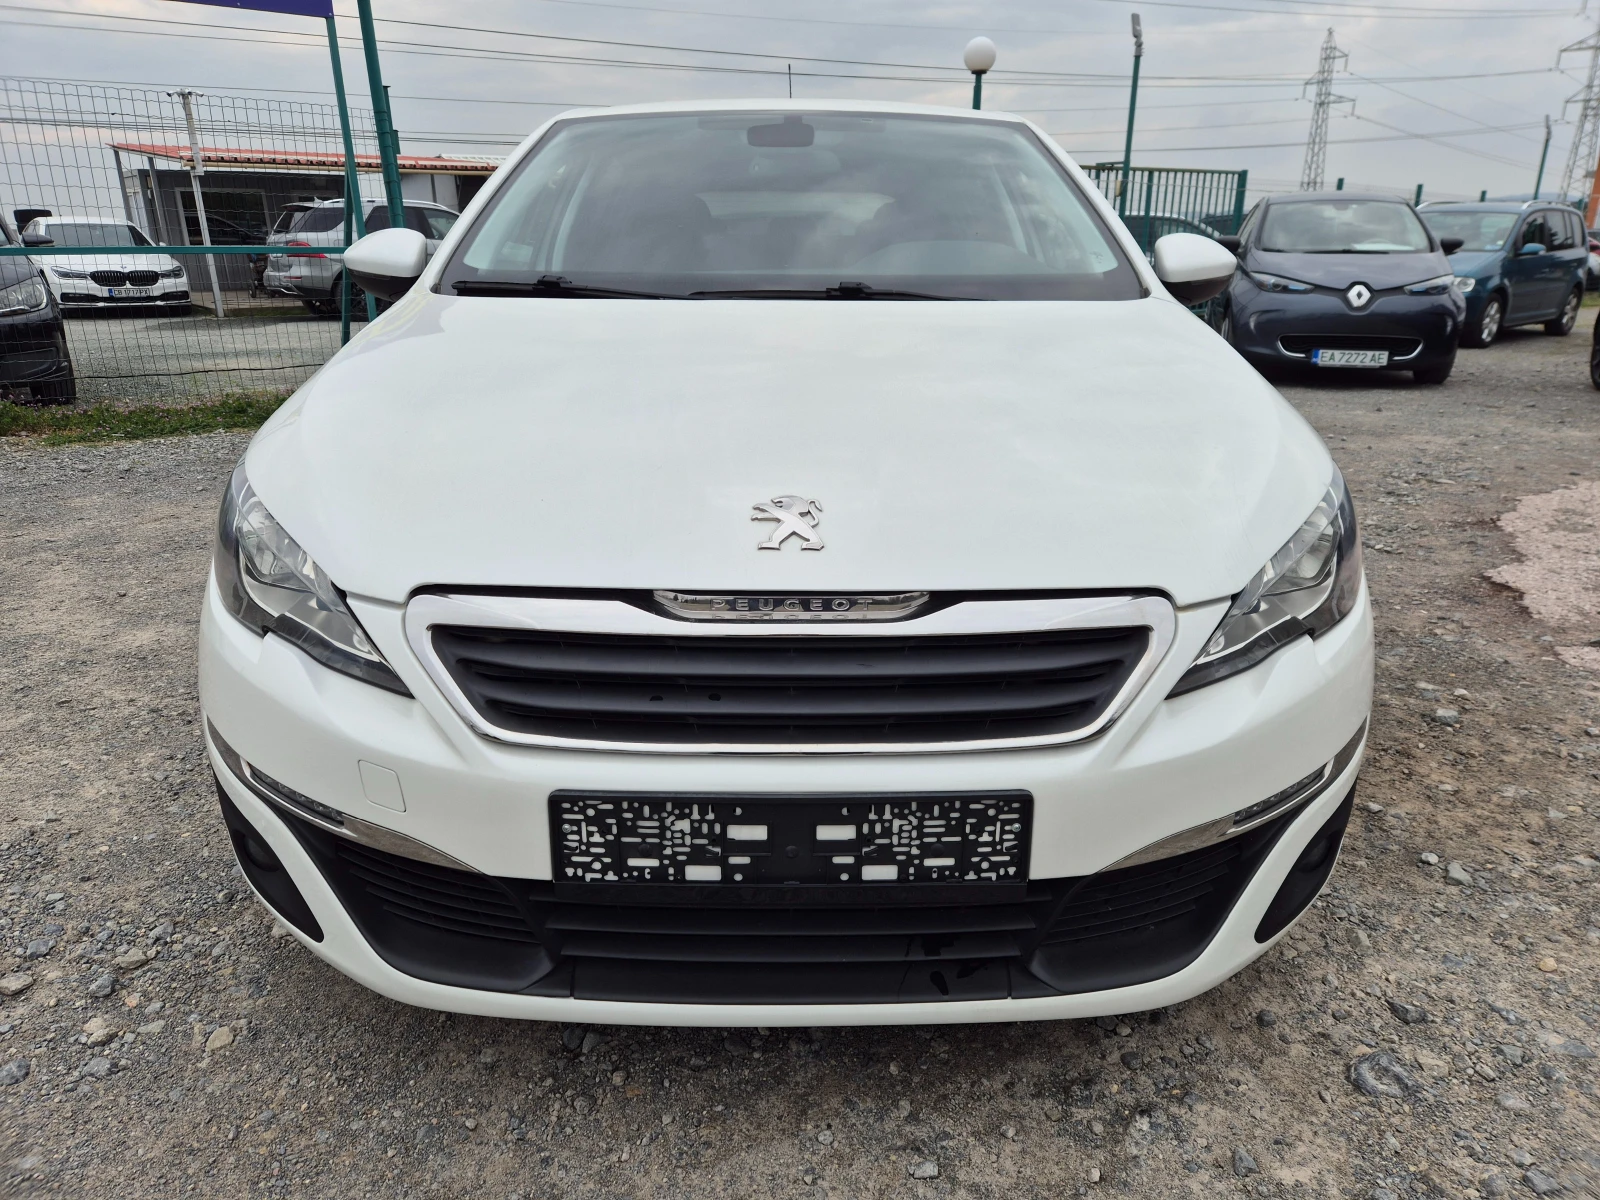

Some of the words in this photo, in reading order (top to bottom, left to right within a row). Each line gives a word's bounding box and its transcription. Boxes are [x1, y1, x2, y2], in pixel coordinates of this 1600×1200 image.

[1320, 352, 1336, 362] EA
[1338, 352, 1368, 364] 7272
[1369, 352, 1386, 364] AE
[711, 598, 873, 611] PEUGEOT
